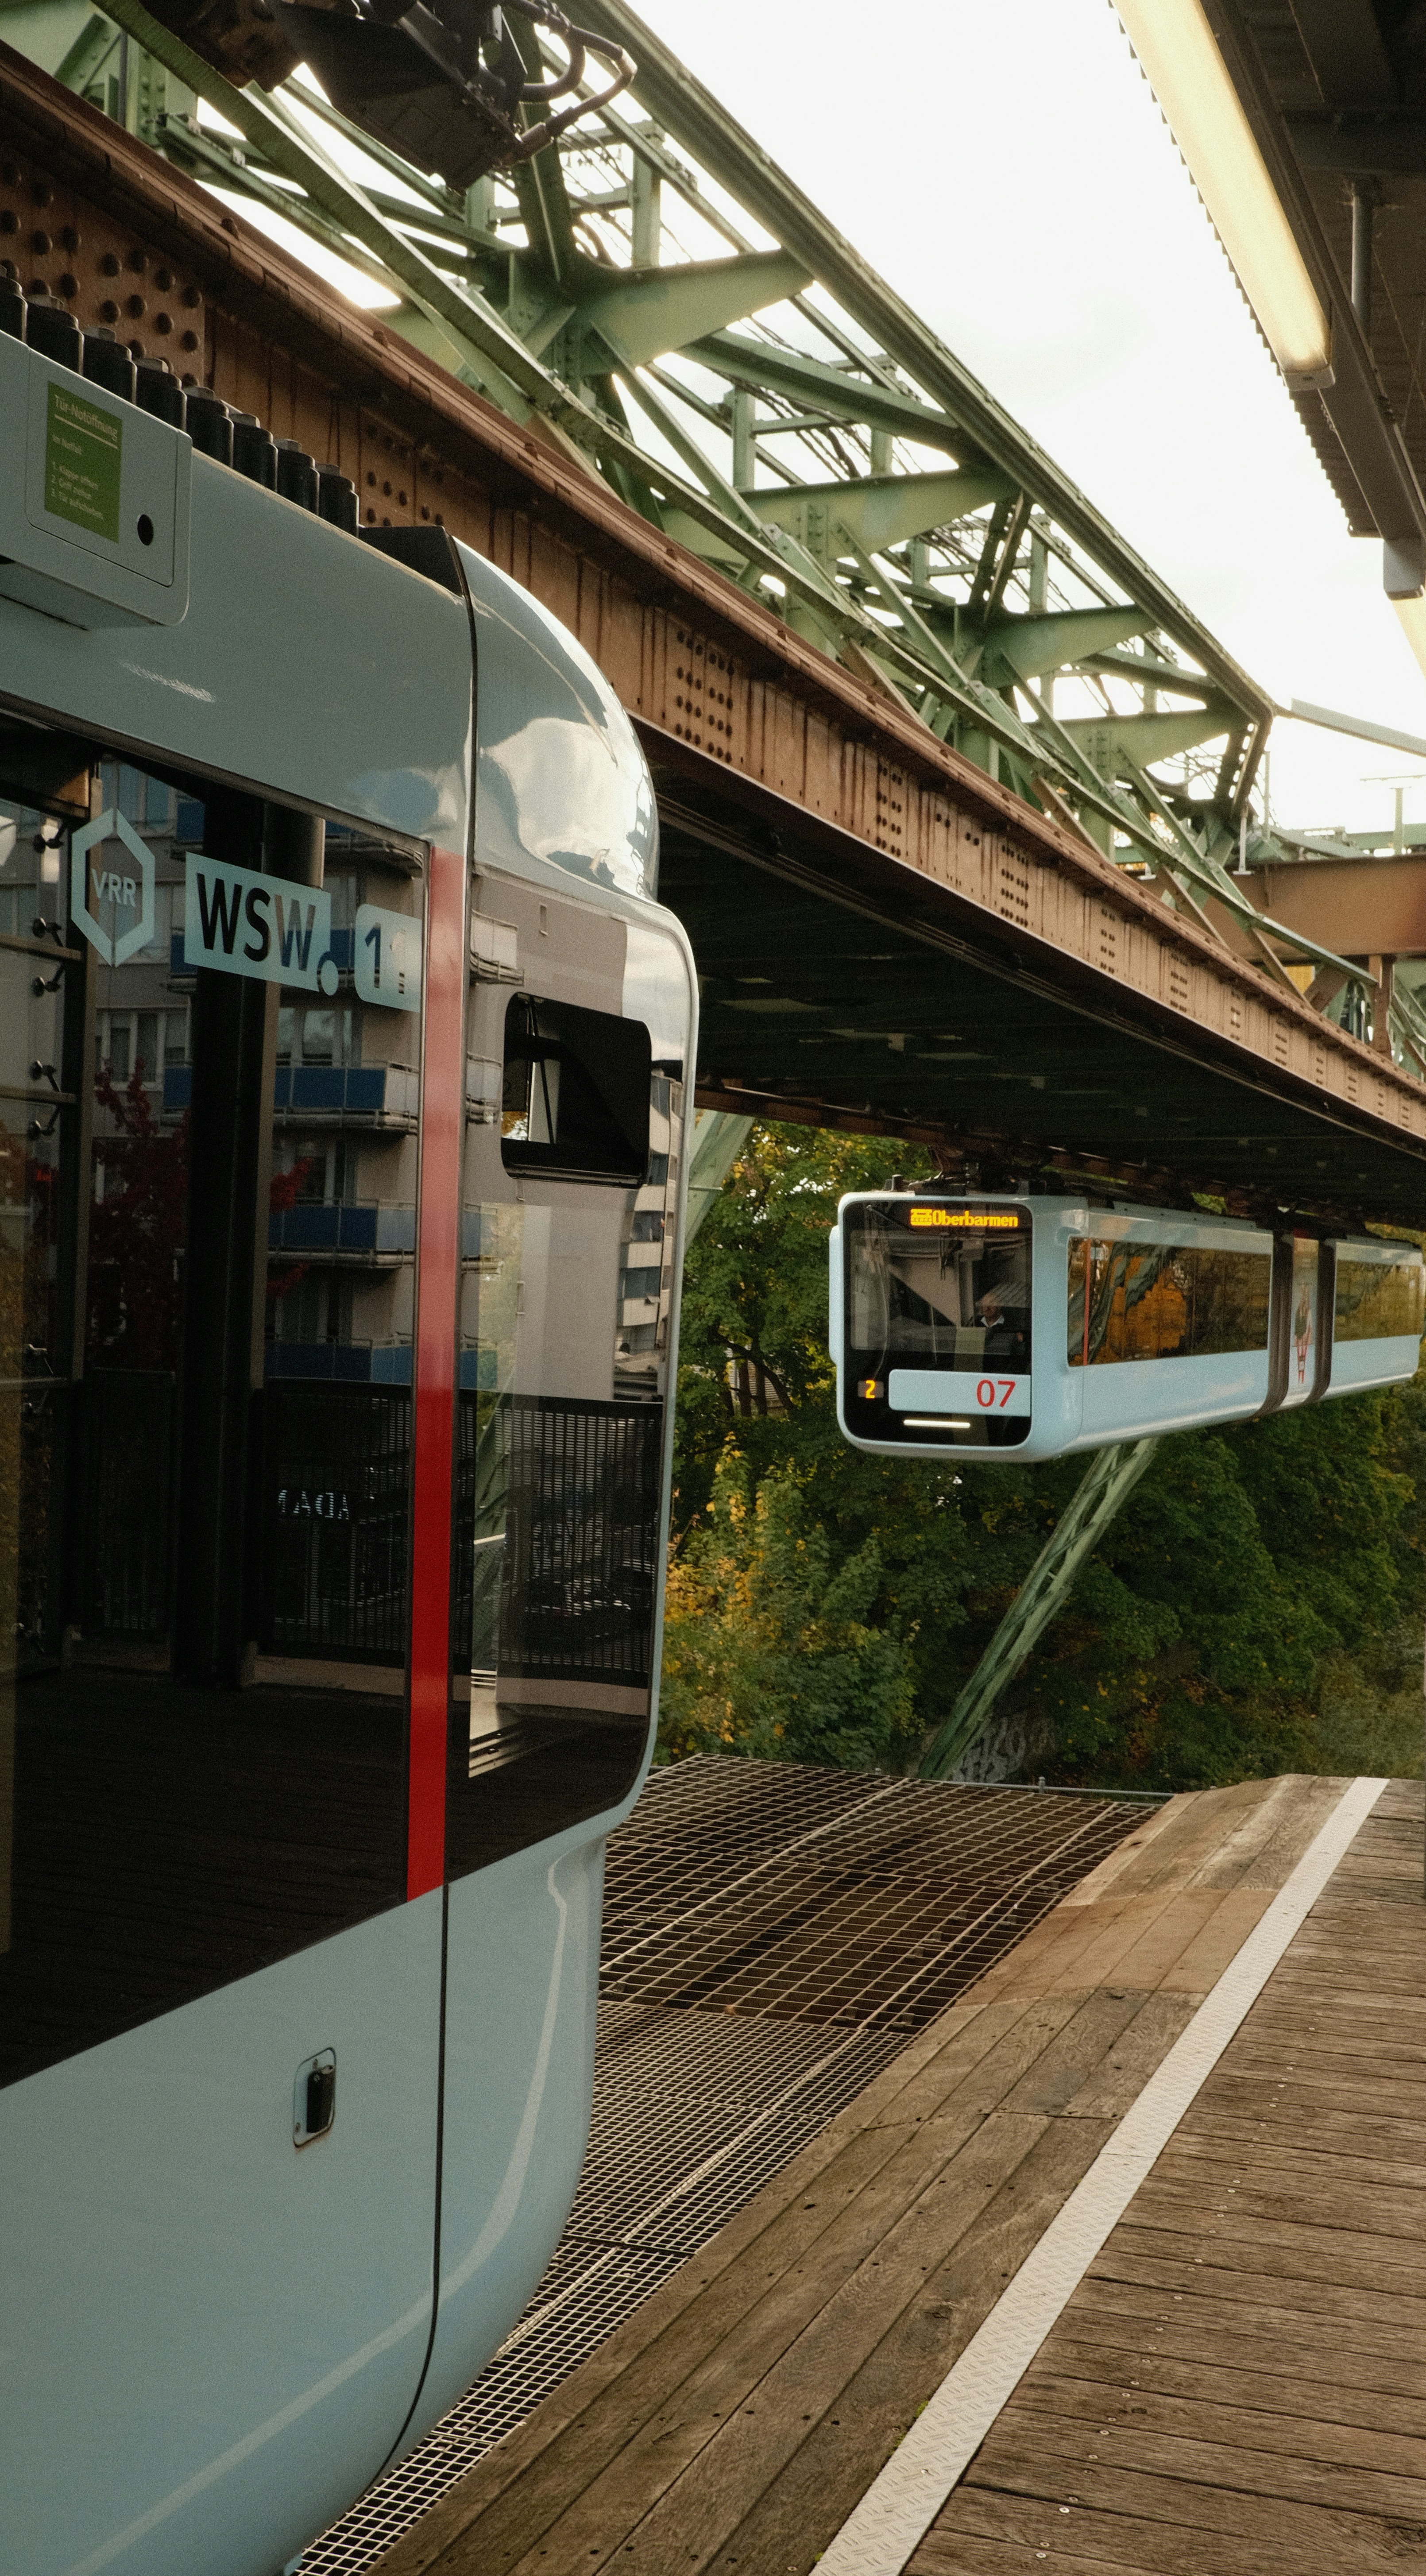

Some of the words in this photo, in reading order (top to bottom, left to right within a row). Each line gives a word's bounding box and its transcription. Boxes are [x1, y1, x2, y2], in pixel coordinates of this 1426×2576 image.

[91, 868, 136, 908] VRR
[932, 1210, 1018, 1227] Oberbarmen
[866, 1380, 875, 1398] 2
[977, 1379, 1016, 1408] 07
